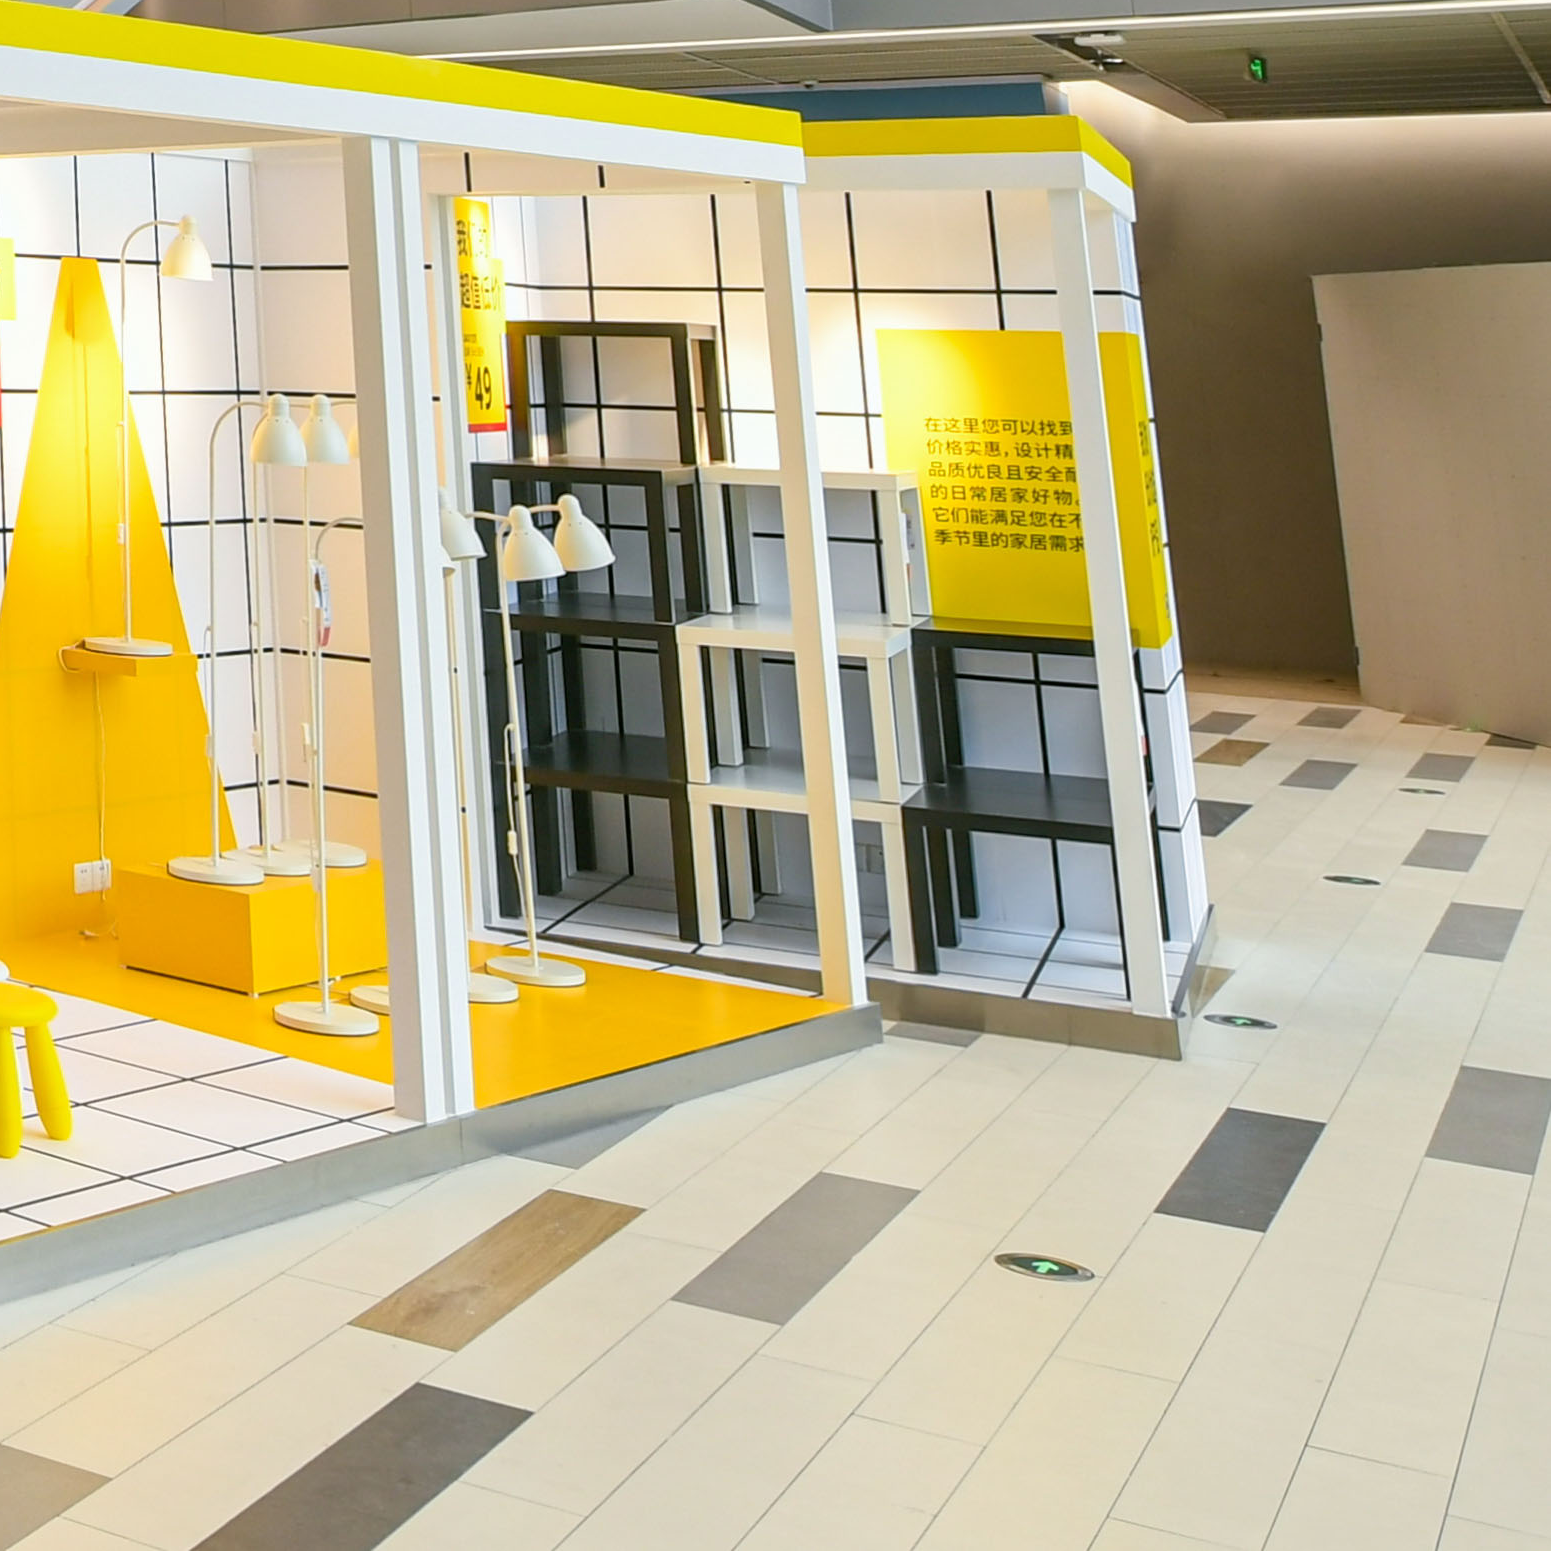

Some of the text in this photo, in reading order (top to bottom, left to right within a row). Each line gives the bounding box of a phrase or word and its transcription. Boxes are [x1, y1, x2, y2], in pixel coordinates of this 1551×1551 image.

[924, 417, 1073, 437] 在这里您可以找到
[935, 529, 1085, 553] 季节里的家居需求
